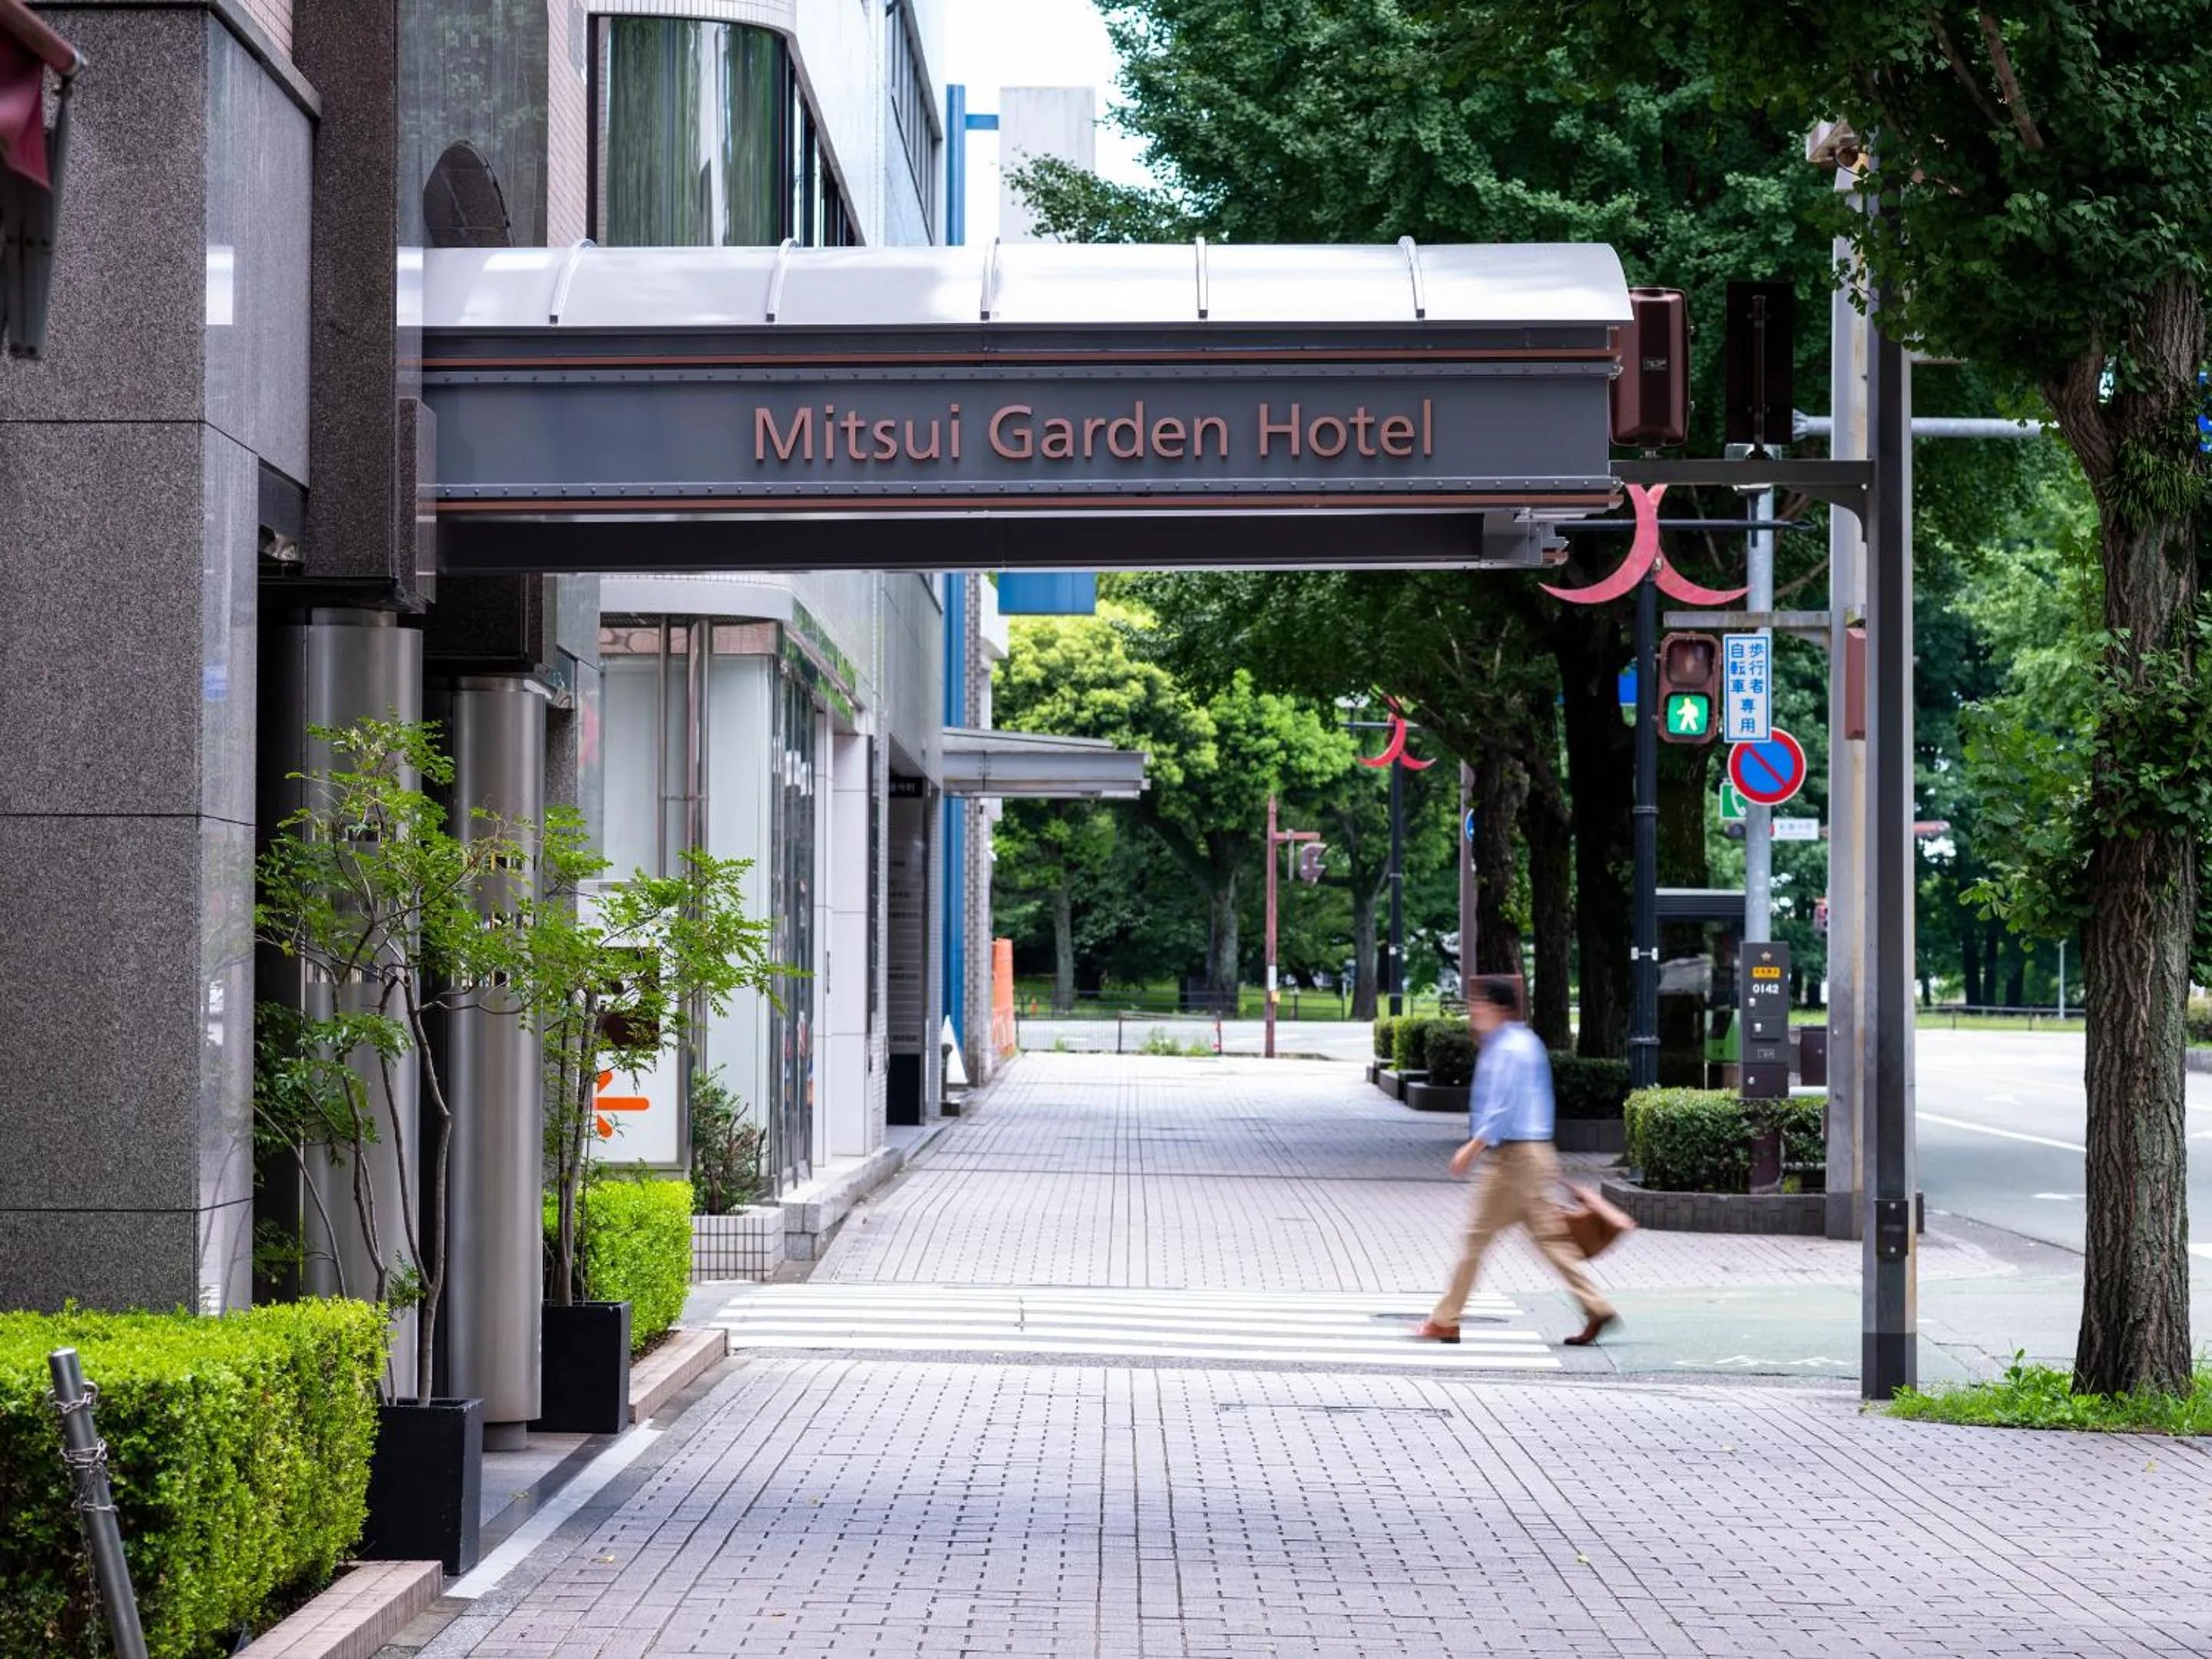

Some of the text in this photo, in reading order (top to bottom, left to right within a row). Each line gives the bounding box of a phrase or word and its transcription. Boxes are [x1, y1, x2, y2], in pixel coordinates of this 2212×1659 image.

[755, 399, 1432, 460] Mitsui Garden Hotel
[1730, 642, 1746, 694] 自転車
[1749, 642, 1764, 694] 歩行者
[1740, 697, 1756, 733] 専用
[1752, 983, 1780, 995] 0142
